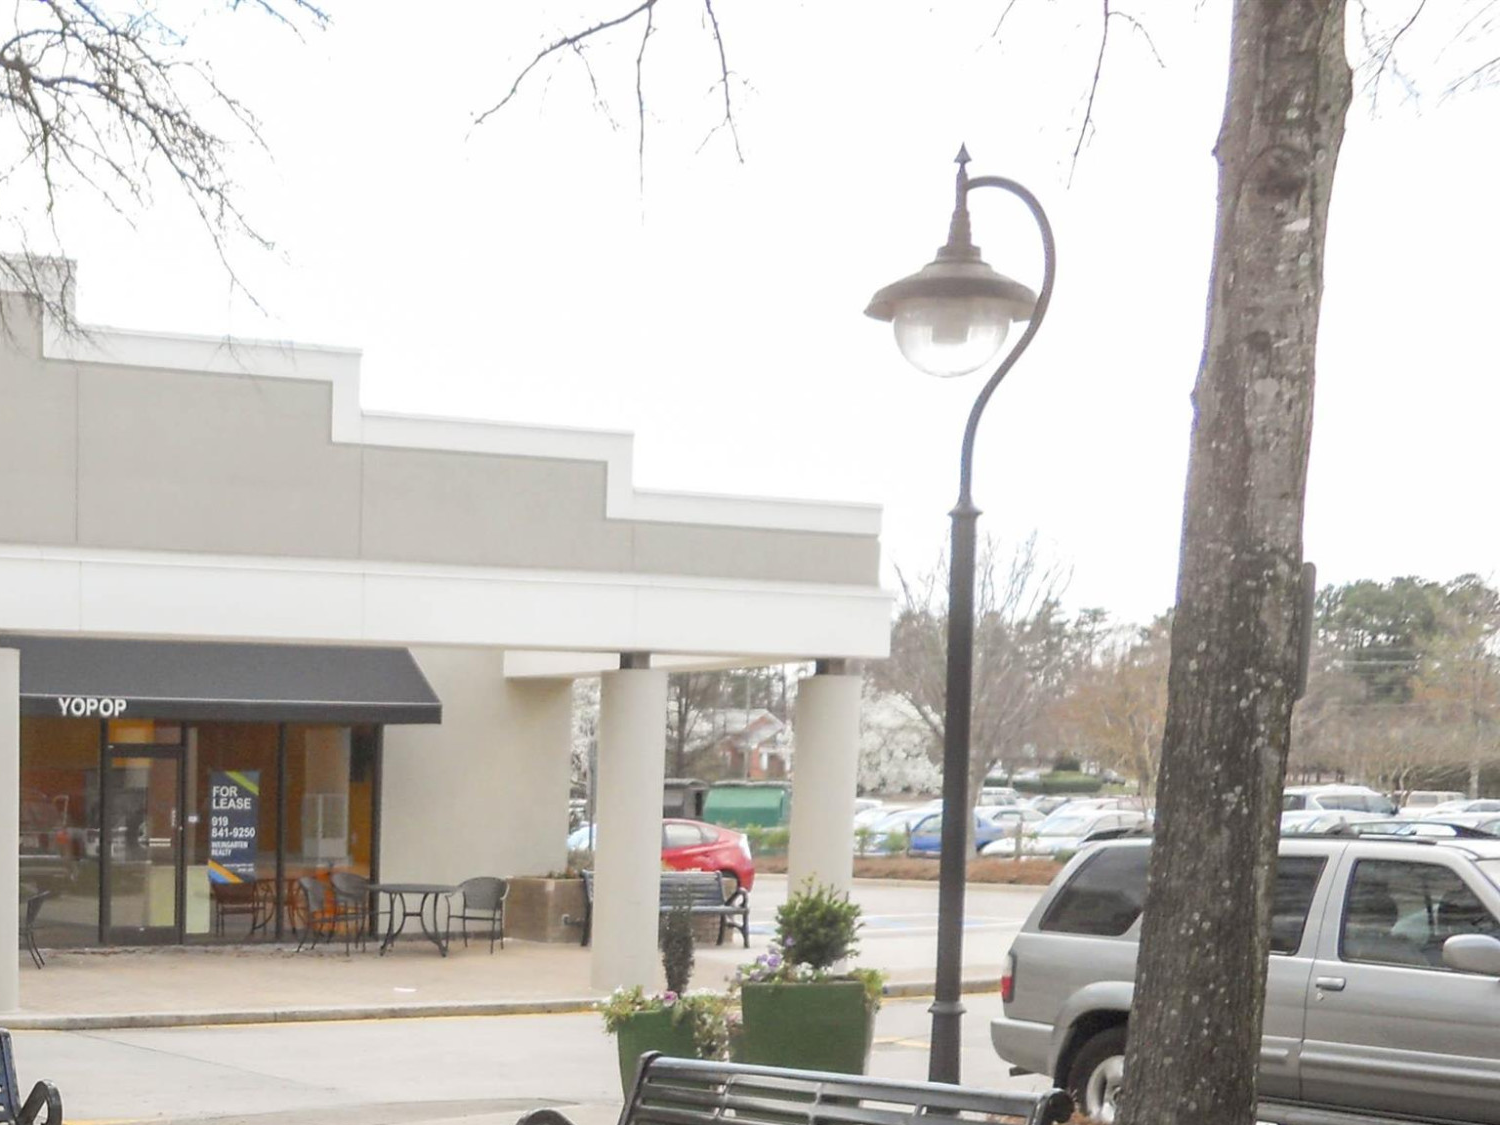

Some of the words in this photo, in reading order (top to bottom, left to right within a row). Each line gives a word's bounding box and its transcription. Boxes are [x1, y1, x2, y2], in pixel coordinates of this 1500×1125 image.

[58, 697, 127, 718] YOPOP
[212, 786, 238, 797] FOR
[212, 798, 252, 809] LEASE
[211, 816, 229, 826] 919
[211, 827, 256, 838] 841-9250
